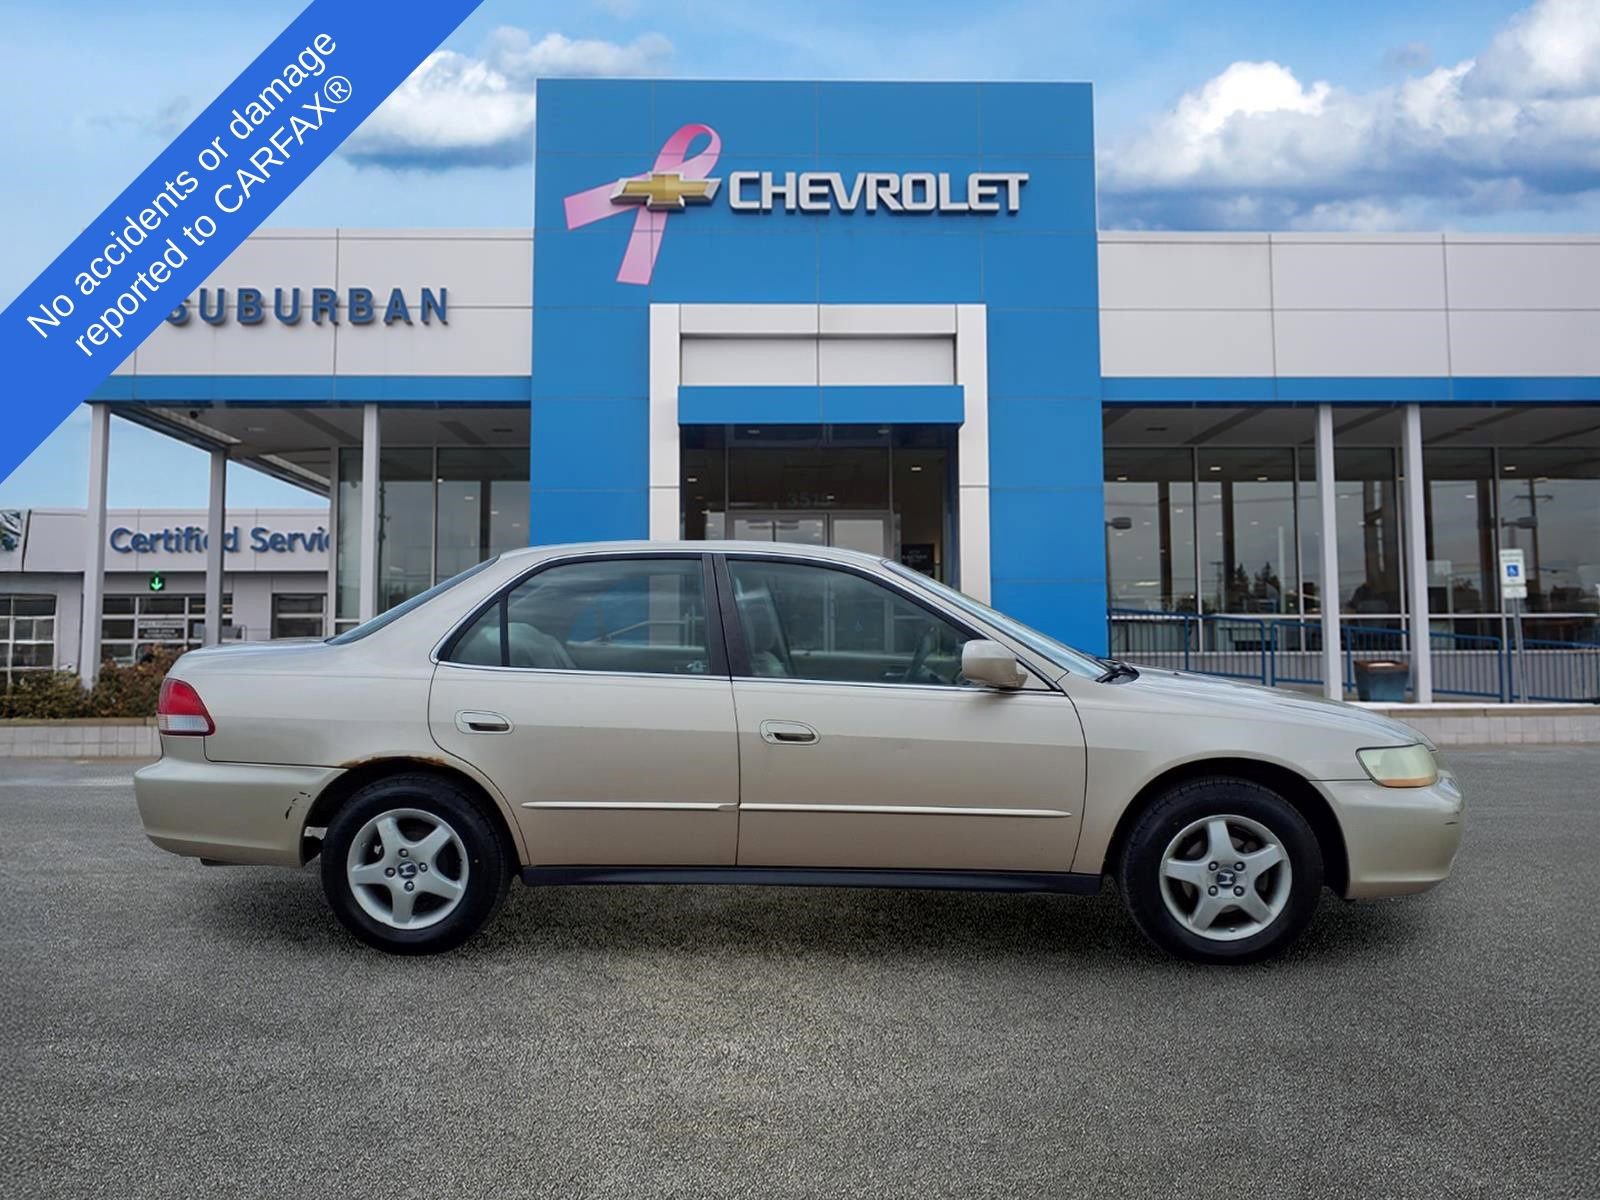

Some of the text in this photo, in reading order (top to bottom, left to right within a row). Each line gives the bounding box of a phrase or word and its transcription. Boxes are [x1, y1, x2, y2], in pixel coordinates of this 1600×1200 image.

[729, 171, 1029, 213] CHEVROLET
[110, 526, 329, 553] Certifid Servi
